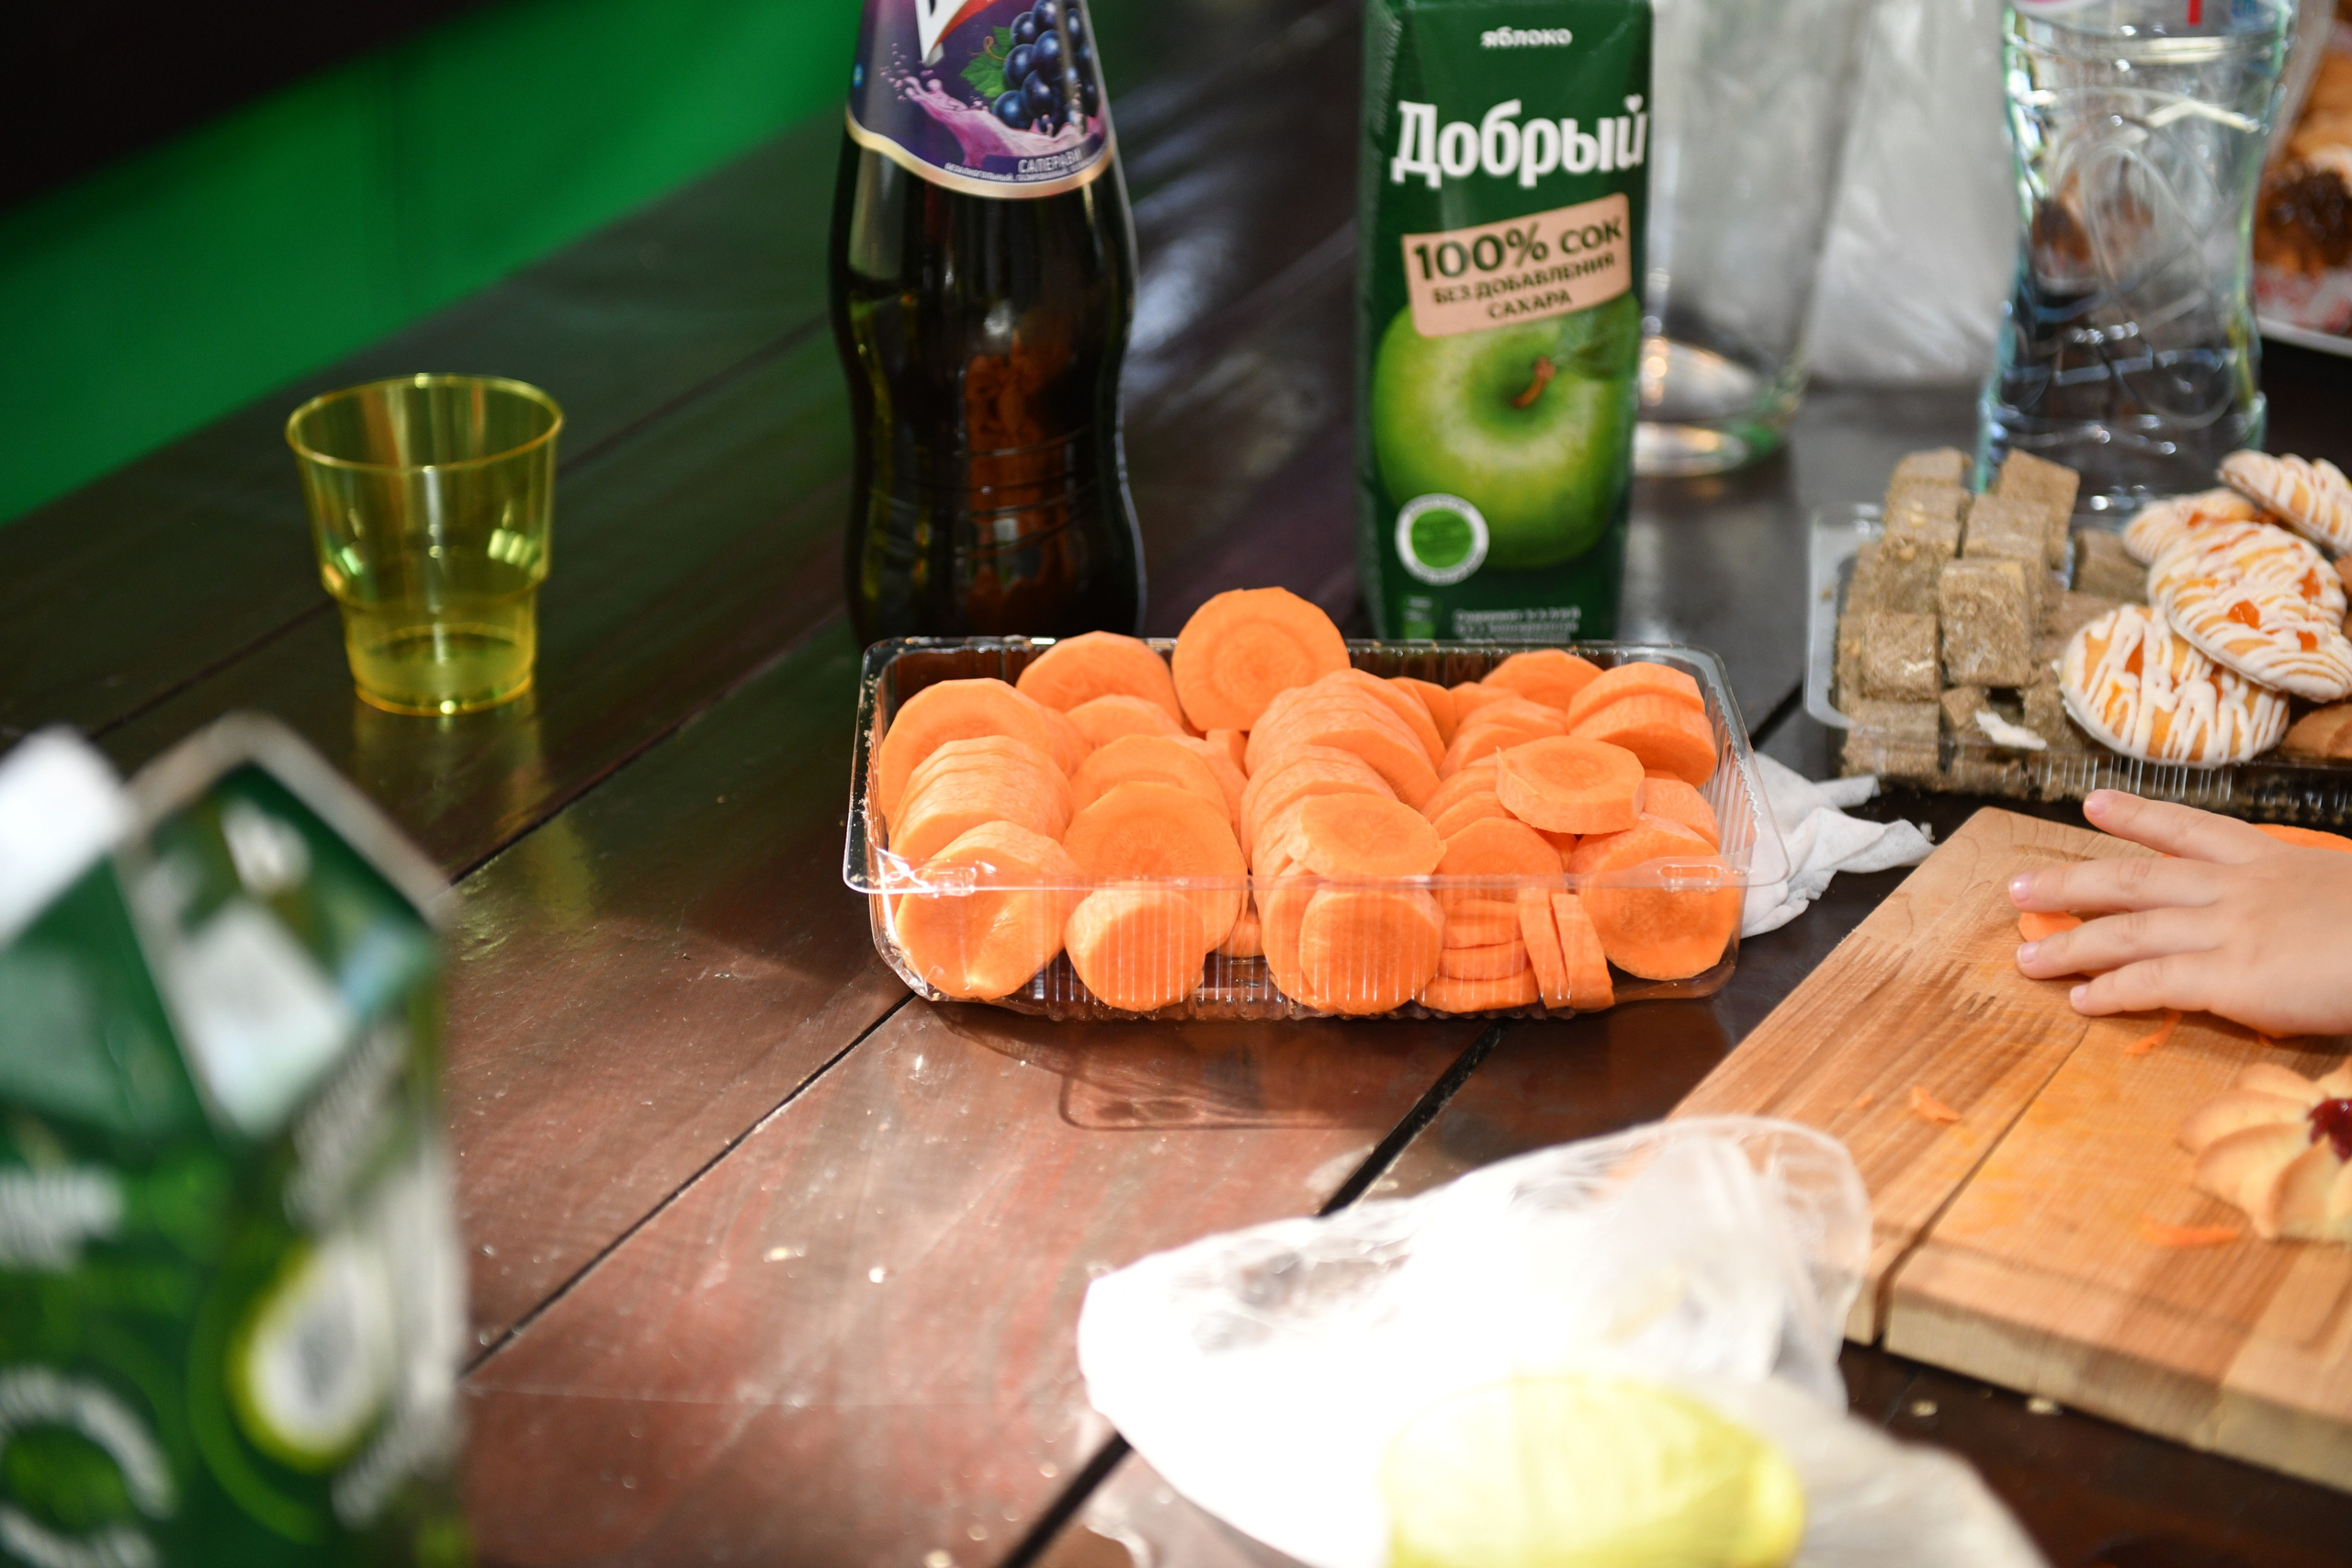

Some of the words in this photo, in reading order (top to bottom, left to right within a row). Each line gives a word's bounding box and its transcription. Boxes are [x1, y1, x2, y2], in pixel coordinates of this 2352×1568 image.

[1480, 26, 1573, 48] яблоко
[1017, 147, 1082, 174] САПЕРАВИ
[1391, 94, 1648, 189] Добрый
[1414, 221, 1549, 281] 100%
[1559, 215, 1623, 255] СОК
[1433, 284, 1471, 305] БЕЗ
[1475, 252, 1615, 300] ДОБАВЛЕНИЯ
[1487, 289, 1573, 320] САХАРА
